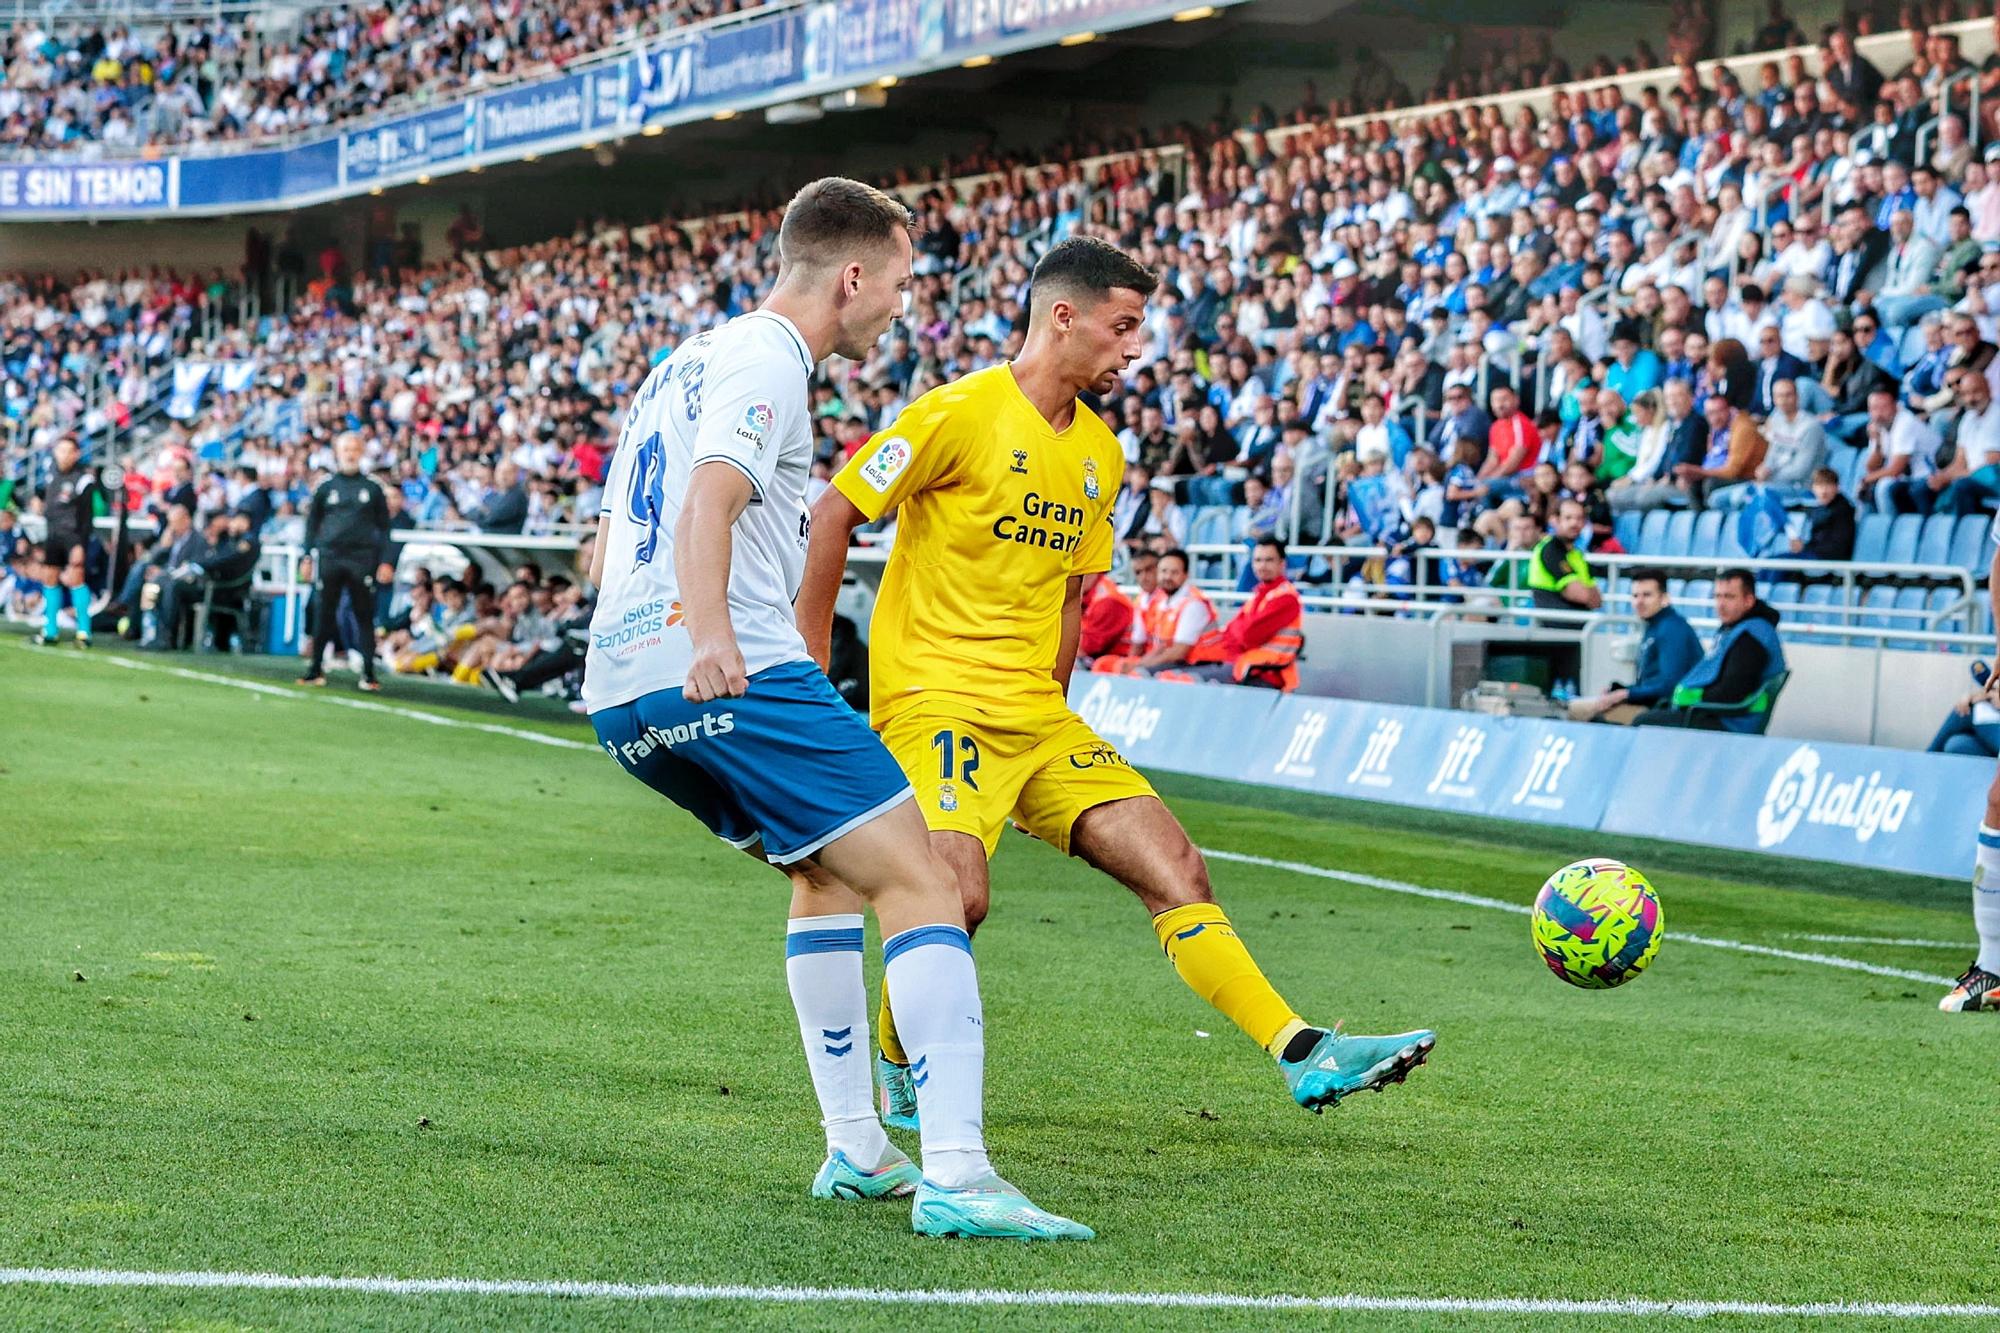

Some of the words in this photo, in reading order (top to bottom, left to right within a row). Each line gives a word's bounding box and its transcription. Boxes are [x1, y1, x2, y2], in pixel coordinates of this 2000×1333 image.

[25, 169, 73, 206] SIN
[75, 165, 165, 205] TEMOR
[865, 464, 887, 486] LaLiga
[1023, 492, 1084, 527] Gran
[623, 598, 664, 625] Islas
[592, 616, 662, 649] Canarias
[1098, 694, 1162, 748] LaLiga
[931, 730, 980, 792] 12
[1806, 770, 1914, 843] LaLiga
